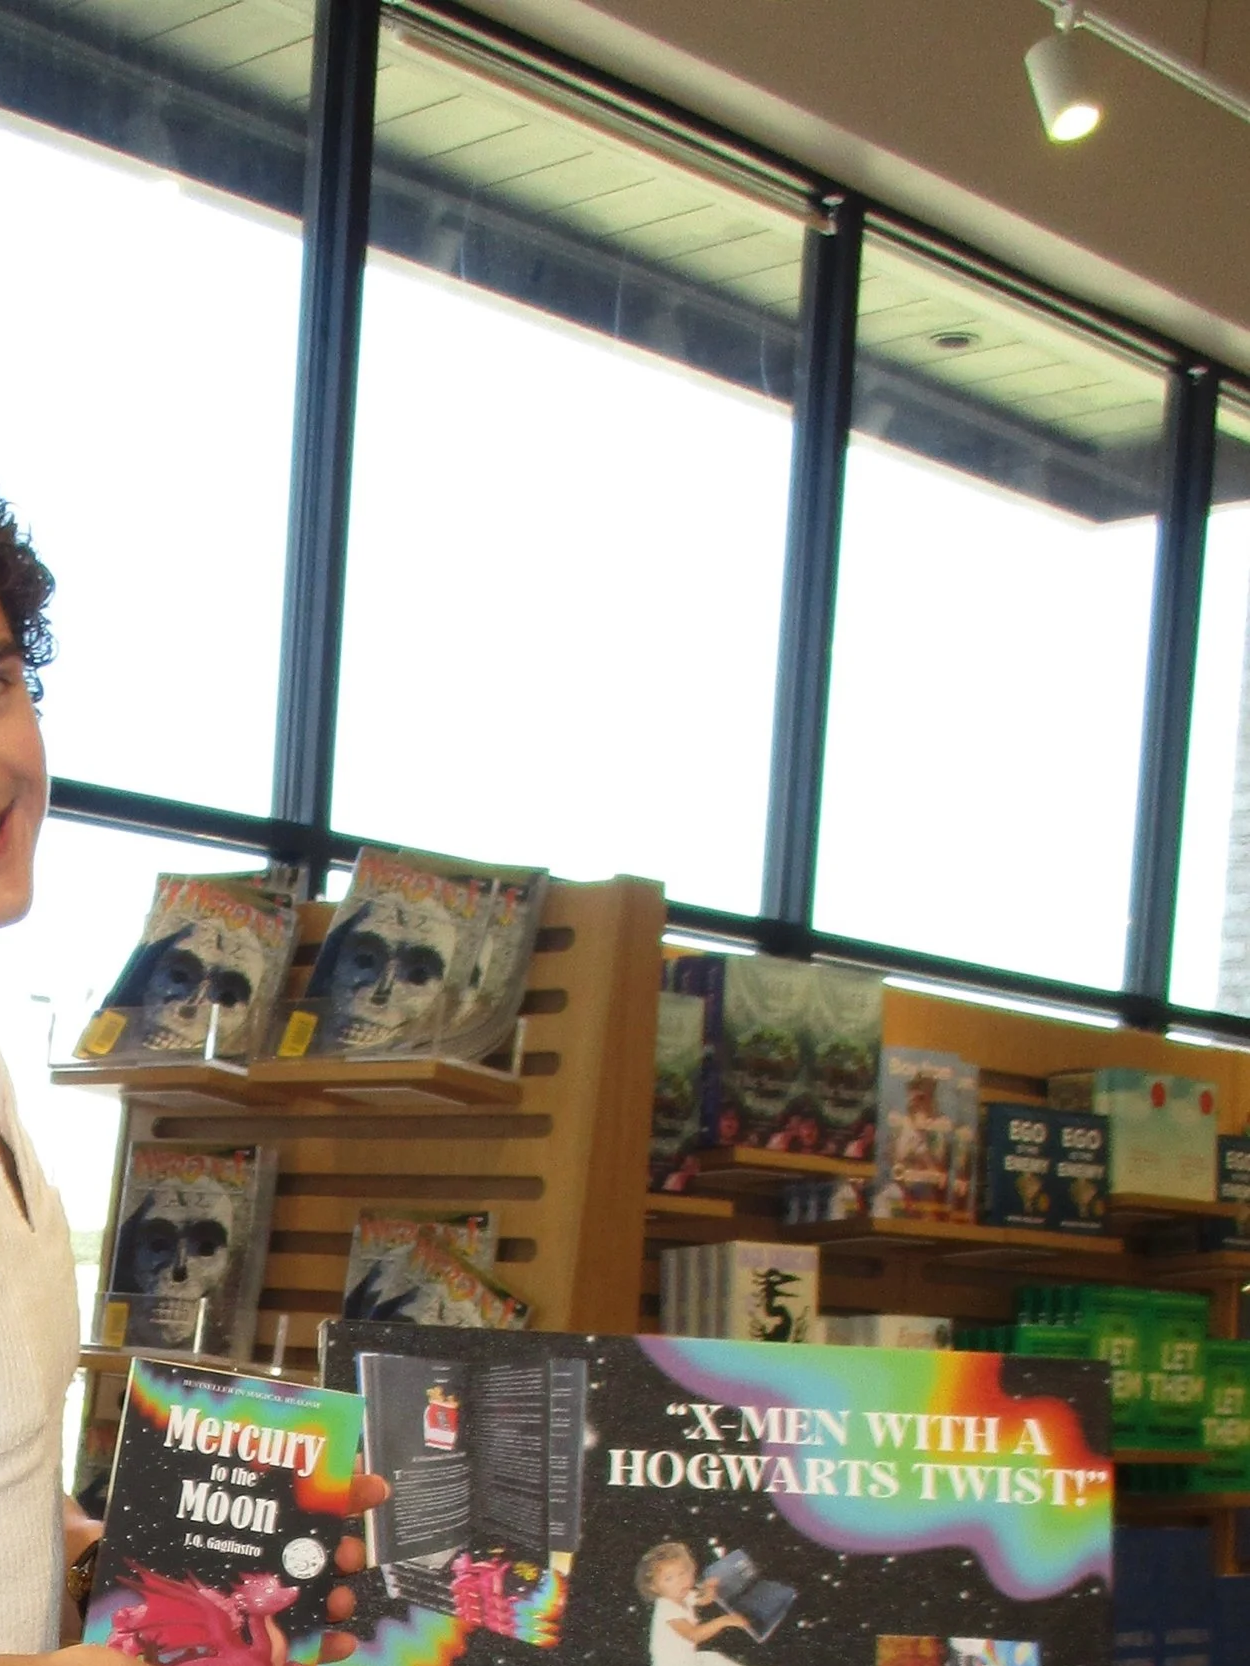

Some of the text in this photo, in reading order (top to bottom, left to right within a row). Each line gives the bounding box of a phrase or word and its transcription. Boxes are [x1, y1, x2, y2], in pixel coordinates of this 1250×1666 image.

[1009, 1118, 1048, 1143] EGO
[1061, 1126, 1101, 1150] EGO
[1161, 1341, 1198, 1371] LET
[1150, 1373, 1205, 1402] THEM
[163, 1404, 327, 1478] Mercury
[665, 1402, 1051, 1457] “X-MEN WITH A
[210, 1463, 259, 1488] to the
[607, 1448, 1108, 1507] HOGWARTS TWIST!”
[176, 1479, 278, 1535] Moon
[184, 1533, 261, 1558] J.Q. Gagliastro
